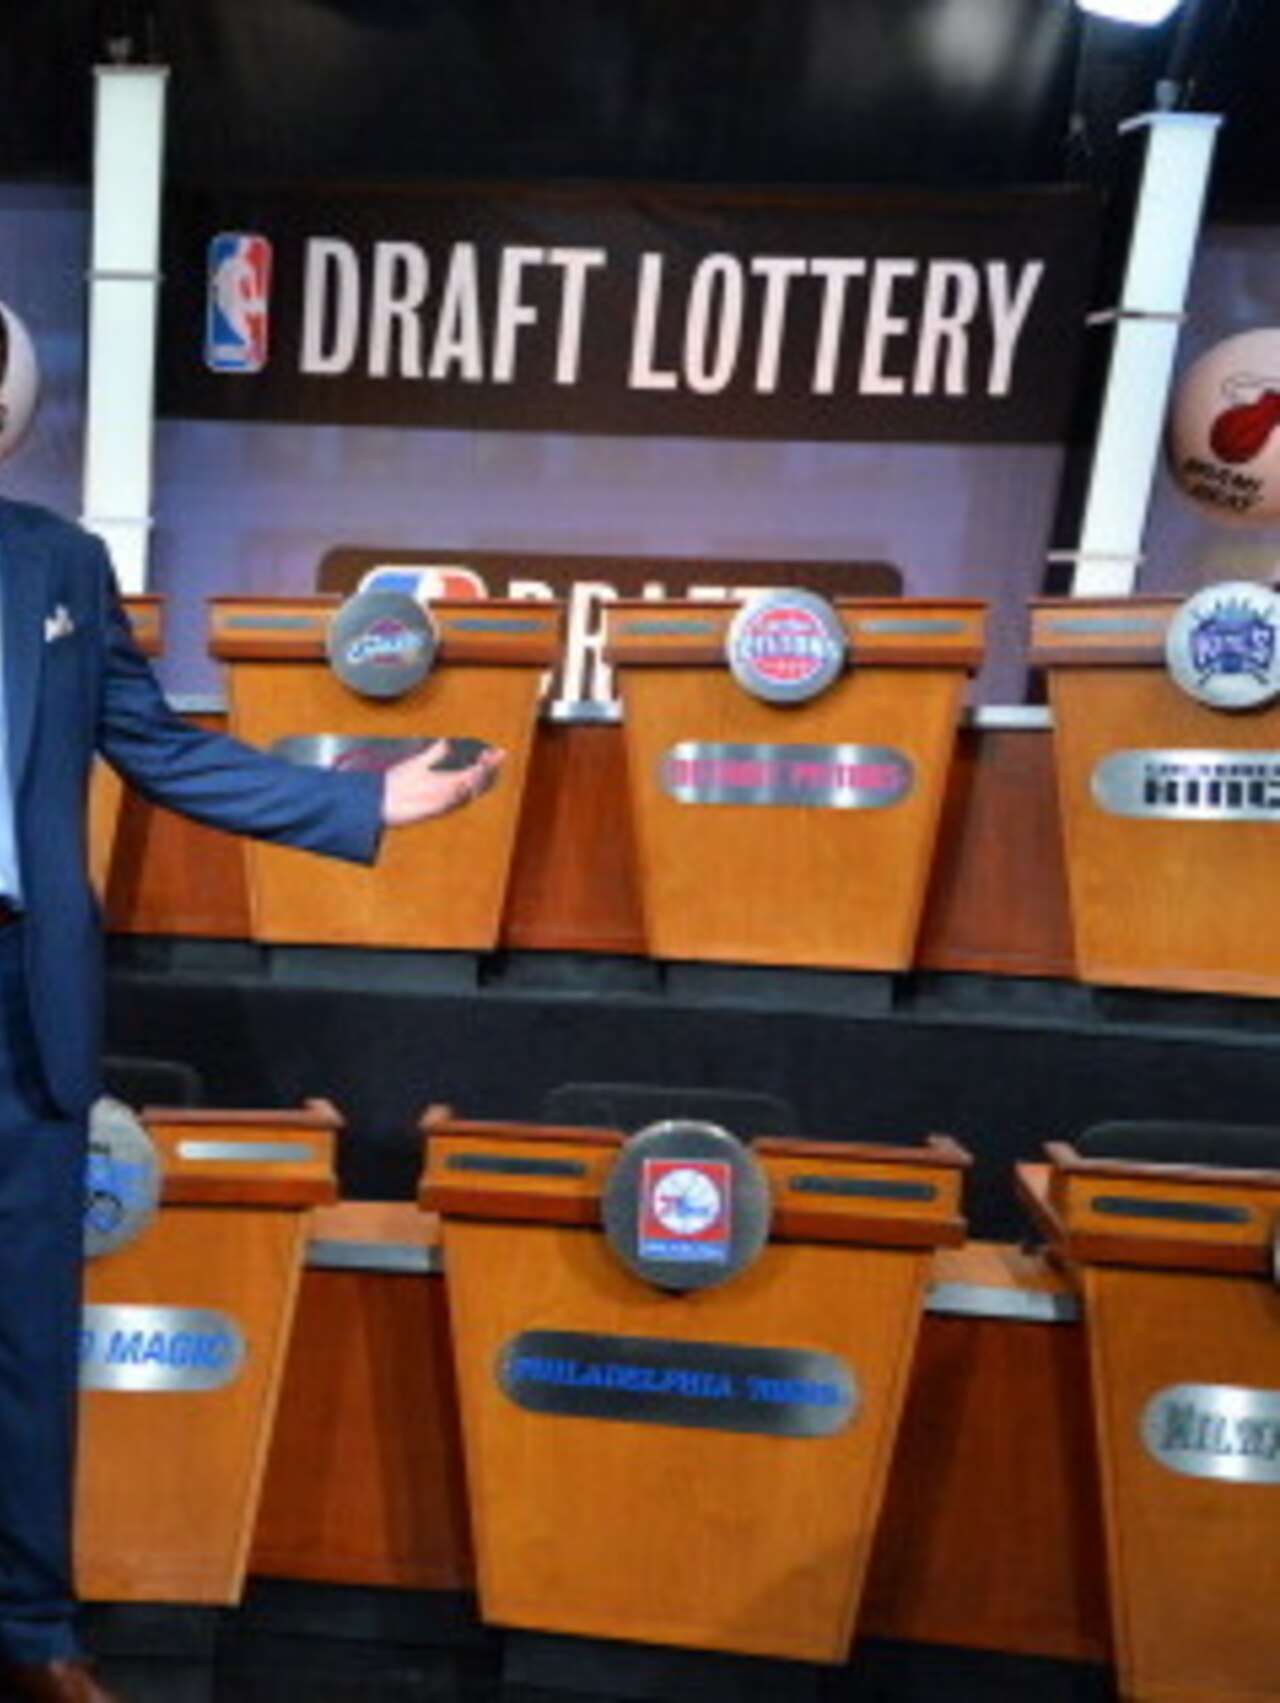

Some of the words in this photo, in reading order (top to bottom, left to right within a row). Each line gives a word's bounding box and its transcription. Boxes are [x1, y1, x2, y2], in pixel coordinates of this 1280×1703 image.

[298, 237, 607, 387] DRAFT
[627, 251, 1045, 398] LOTTERY
[105, 1330, 233, 1369] MAGIC
[510, 1355, 732, 1397] PHILADELPHIA
